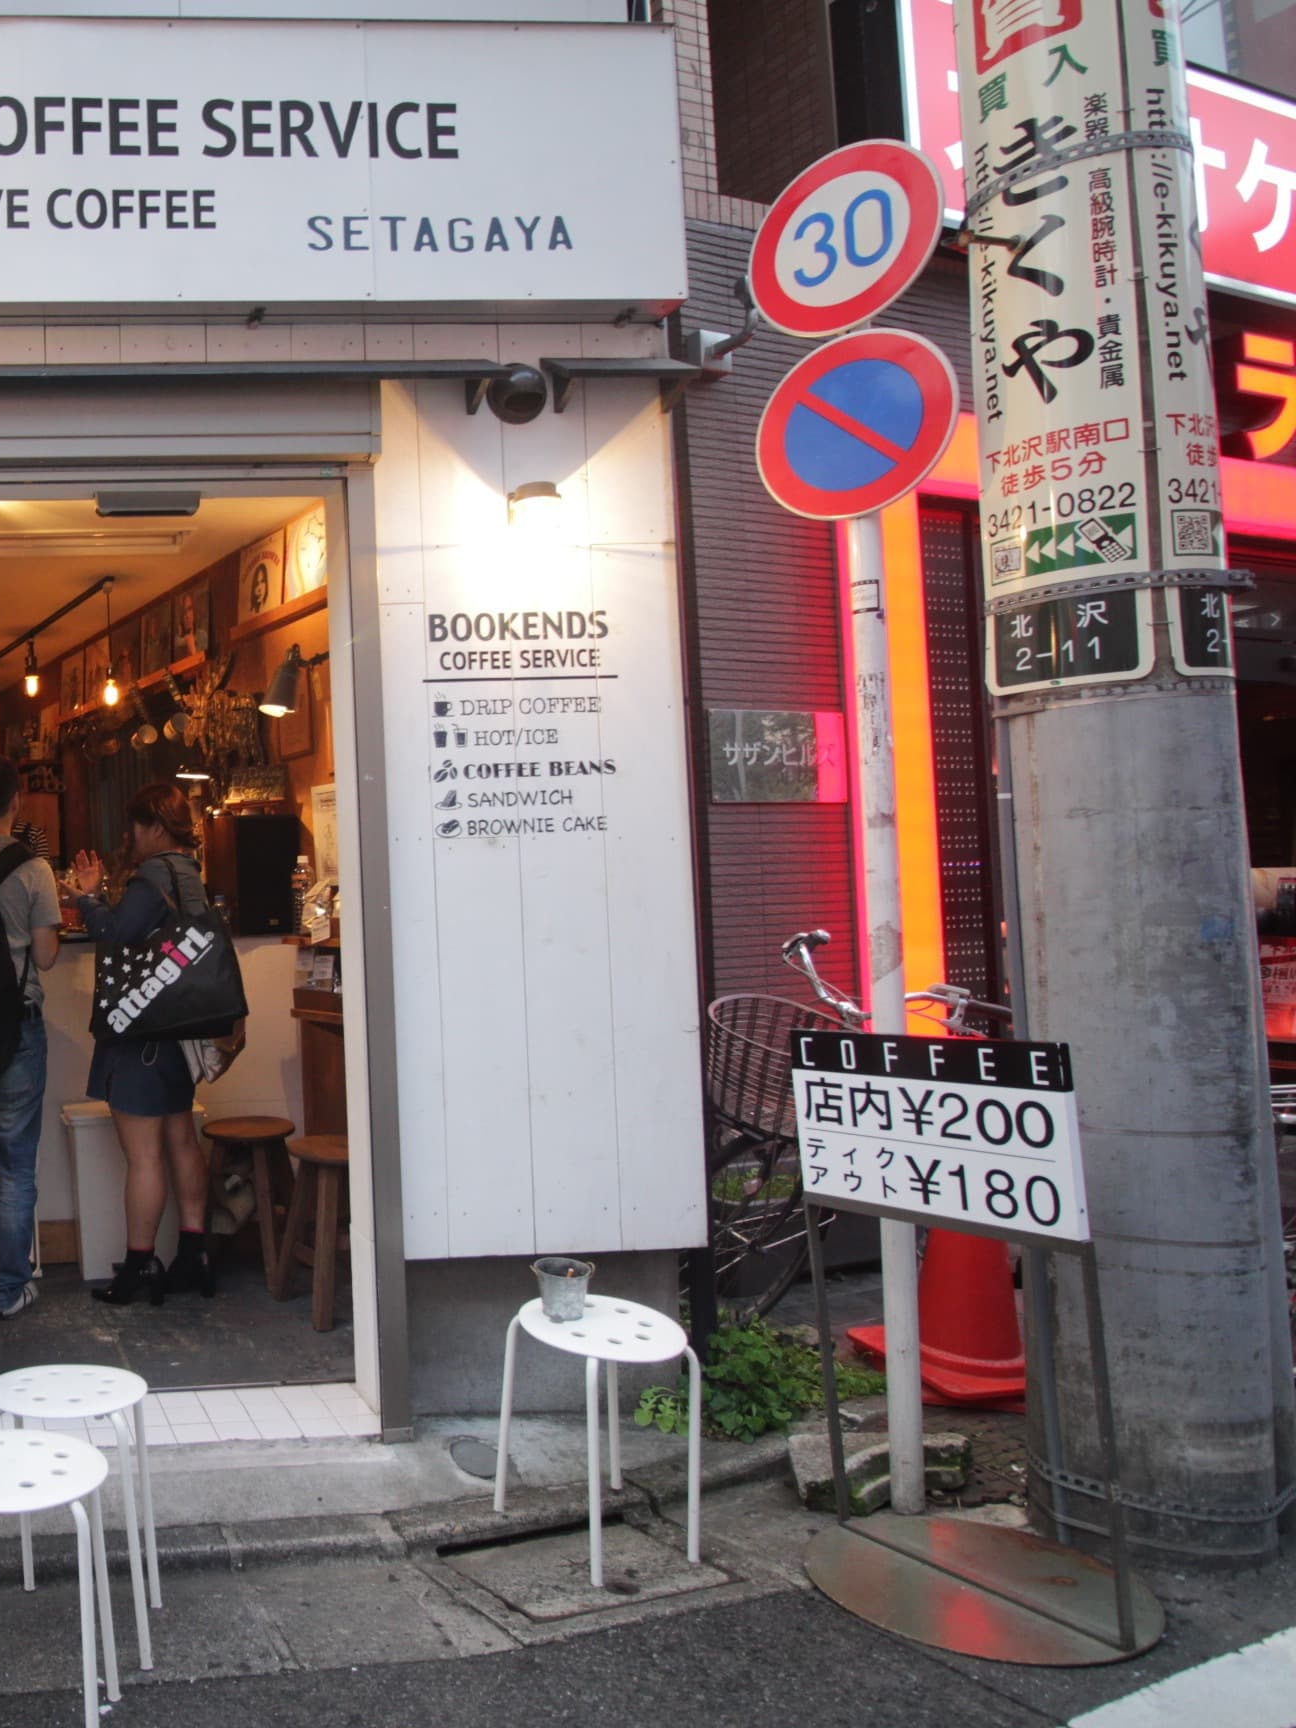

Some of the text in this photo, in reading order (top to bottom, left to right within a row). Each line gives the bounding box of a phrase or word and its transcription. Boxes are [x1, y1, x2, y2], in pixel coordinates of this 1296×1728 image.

[201, 99, 459, 160] SERVICE
[46, 189, 216, 230] COFFEE
[306, 214, 574, 253] SETAGAYA
[793, 188, 894, 288] 30
[985, 417, 1130, 474] 下北沢駅南口
[988, 482, 1137, 538] 3421-0822
[428, 610, 609, 642] BOOKENDS
[439, 648, 601, 671] COFFEE SERVICE
[460, 696, 602, 715] DRIP COFFEE
[474, 728, 559, 747] HOT/ICE
[463, 759, 617, 779] COFFEE BEANS
[467, 789, 573, 808] SANDWICH
[466, 816, 608, 836] BROWNIE CAKE
[106, 926, 208, 1034] attagirl
[800, 1037, 1051, 1086] COFFEE
[904, 1155, 1062, 1227] ¥180
